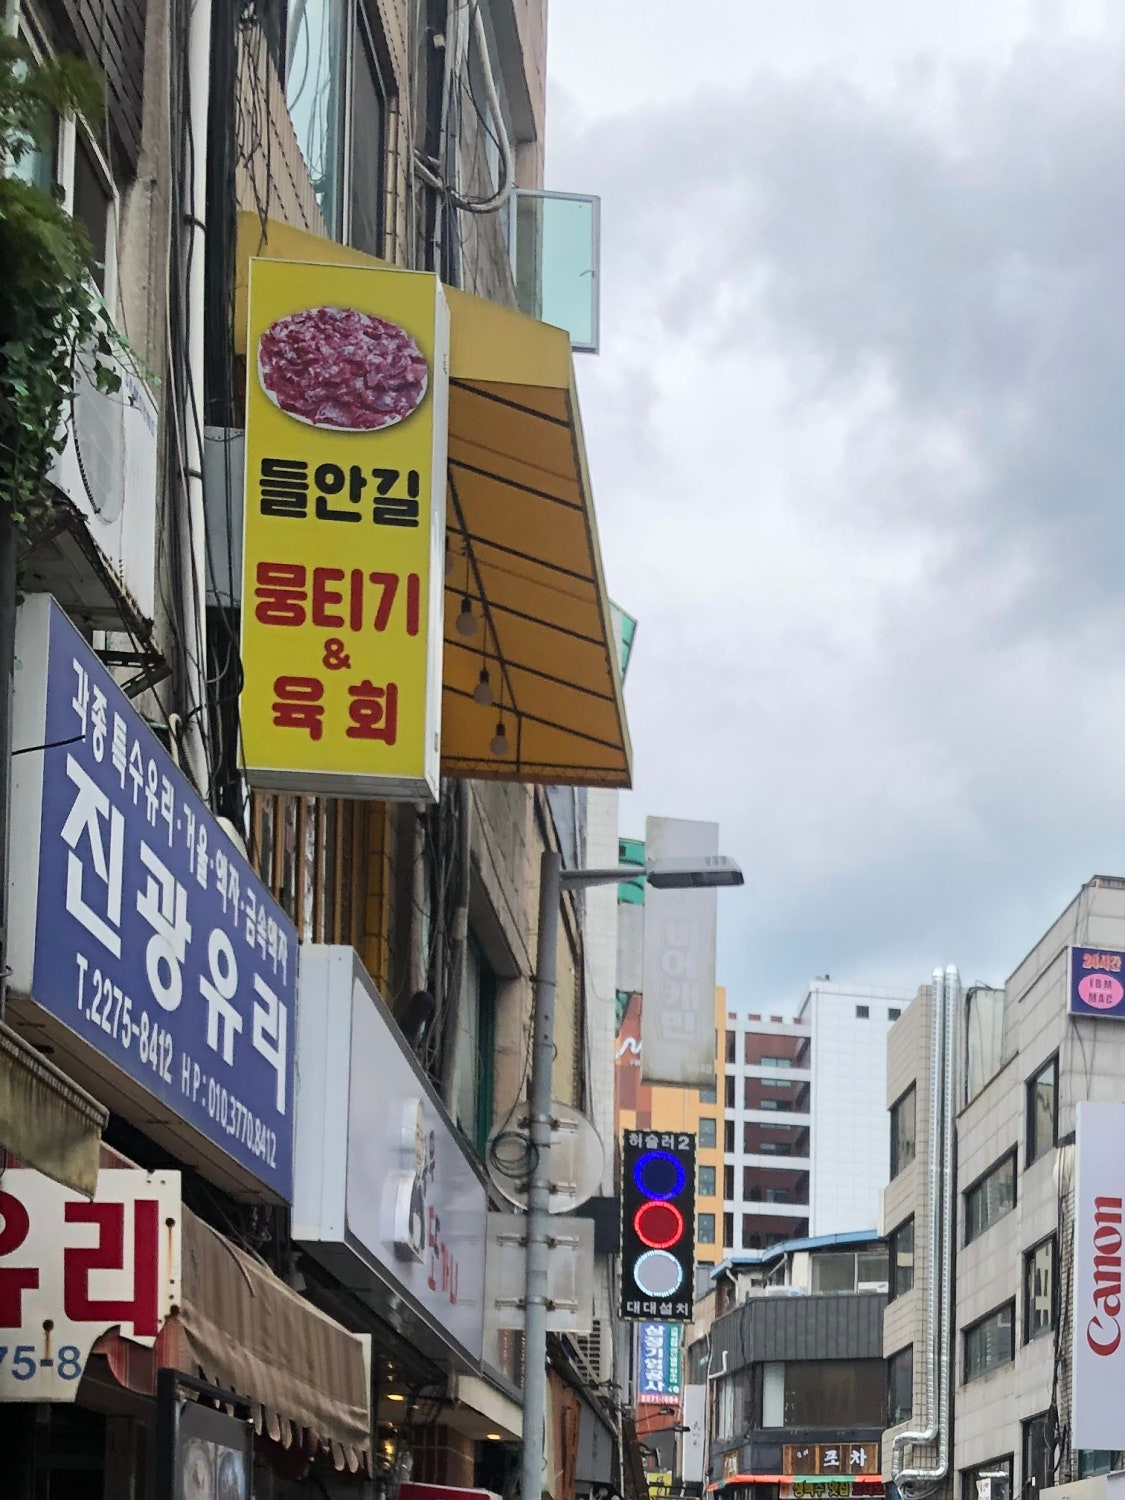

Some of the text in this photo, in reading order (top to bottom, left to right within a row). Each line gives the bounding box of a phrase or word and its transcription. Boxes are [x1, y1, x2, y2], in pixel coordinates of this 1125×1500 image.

[259, 457, 420, 527] 들안길
[254, 561, 420, 636] 뭉티기
[322, 639, 352, 671] &
[272, 676, 398, 746] 육회
[60, 753, 287, 1115] 진광유리
[629, 1131, 690, 1151] 허슬러2
[1087, 1196, 1123, 1356] Canon
